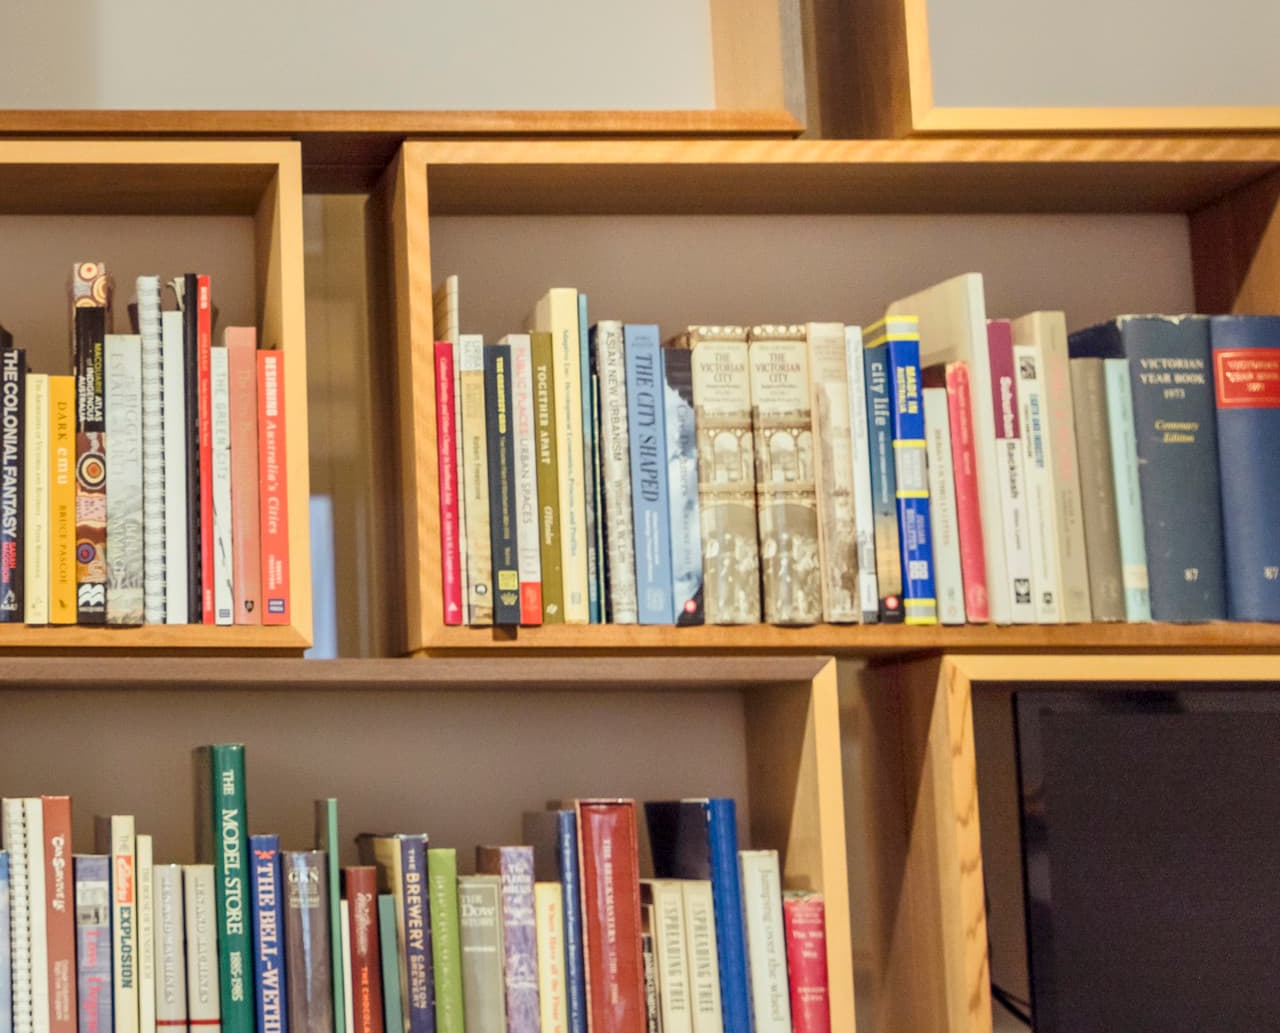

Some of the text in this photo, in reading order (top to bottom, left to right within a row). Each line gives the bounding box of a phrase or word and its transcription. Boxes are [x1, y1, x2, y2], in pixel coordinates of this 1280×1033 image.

[94, 343, 103, 422] MACQUARIE ATLAS
[110, 353, 124, 409] ESTATE
[634, 353, 654, 387] THE
[700, 363, 745, 373] VICTORIAN
[713, 352, 730, 362] THE
[713, 373, 733, 383] CITY
[755, 363, 801, 373] VICTORIAN
[768, 352, 786, 362] THE
[768, 373, 789, 383] CITY
[1140, 357, 1205, 369] VICTORIAN
[1140, 372, 1206, 385] YEAR BOOK
[78, 375, 87, 422] AUSTRALIA
[86, 367, 95, 422] INDIGENOUS
[216, 372, 227, 446] THE GREEN
[537, 365, 551, 465] TOGETHER APART
[605, 331, 622, 462] ASIAN NEW URBANISM
[635, 391, 656, 431] CITY
[870, 362, 890, 427] city life
[896, 365, 907, 415] AUSTRALIA
[905, 365, 919, 415] MADE IN
[0, 350, 19, 538] THE COLONIAL FANTASY
[55, 400, 69, 487] DARK emu
[125, 394, 138, 464] BIGGEST
[264, 356, 280, 535] DESIGNING Australia's Cities
[516, 347, 533, 524] PUBLIC PLACES URBAN SPACES
[999, 375, 1020, 500] Suburban Backlash
[638, 433, 659, 503] SHAPED
[613, 479, 625, 516] William
[9, 541, 17, 569] SARAH
[58, 504, 68, 585] BRUCE PASCOE
[222, 769, 235, 796] THE
[119, 834, 130, 852] THE
[222, 808, 242, 875] MODEL
[225, 876, 243, 935] STORE
[256, 862, 275, 907] THE
[405, 848, 424, 951] THE BREWERY
[461, 895, 483, 904] THE
[461, 904, 496, 918] Dow
[602, 839, 617, 945] THE BRICKMASTERS
[119, 906, 134, 989] EXPLOSION
[549, 903, 559, 993] Where the
[665, 907, 685, 1012] SPREADING TREE
[692, 908, 714, 1014] SPREADING TREE
[758, 869, 784, 1022] Jumping over the wheel
[361, 966, 369, 985] THE
[411, 954, 420, 1008] BREWERY
[418, 954, 427, 1009] CARLTON
